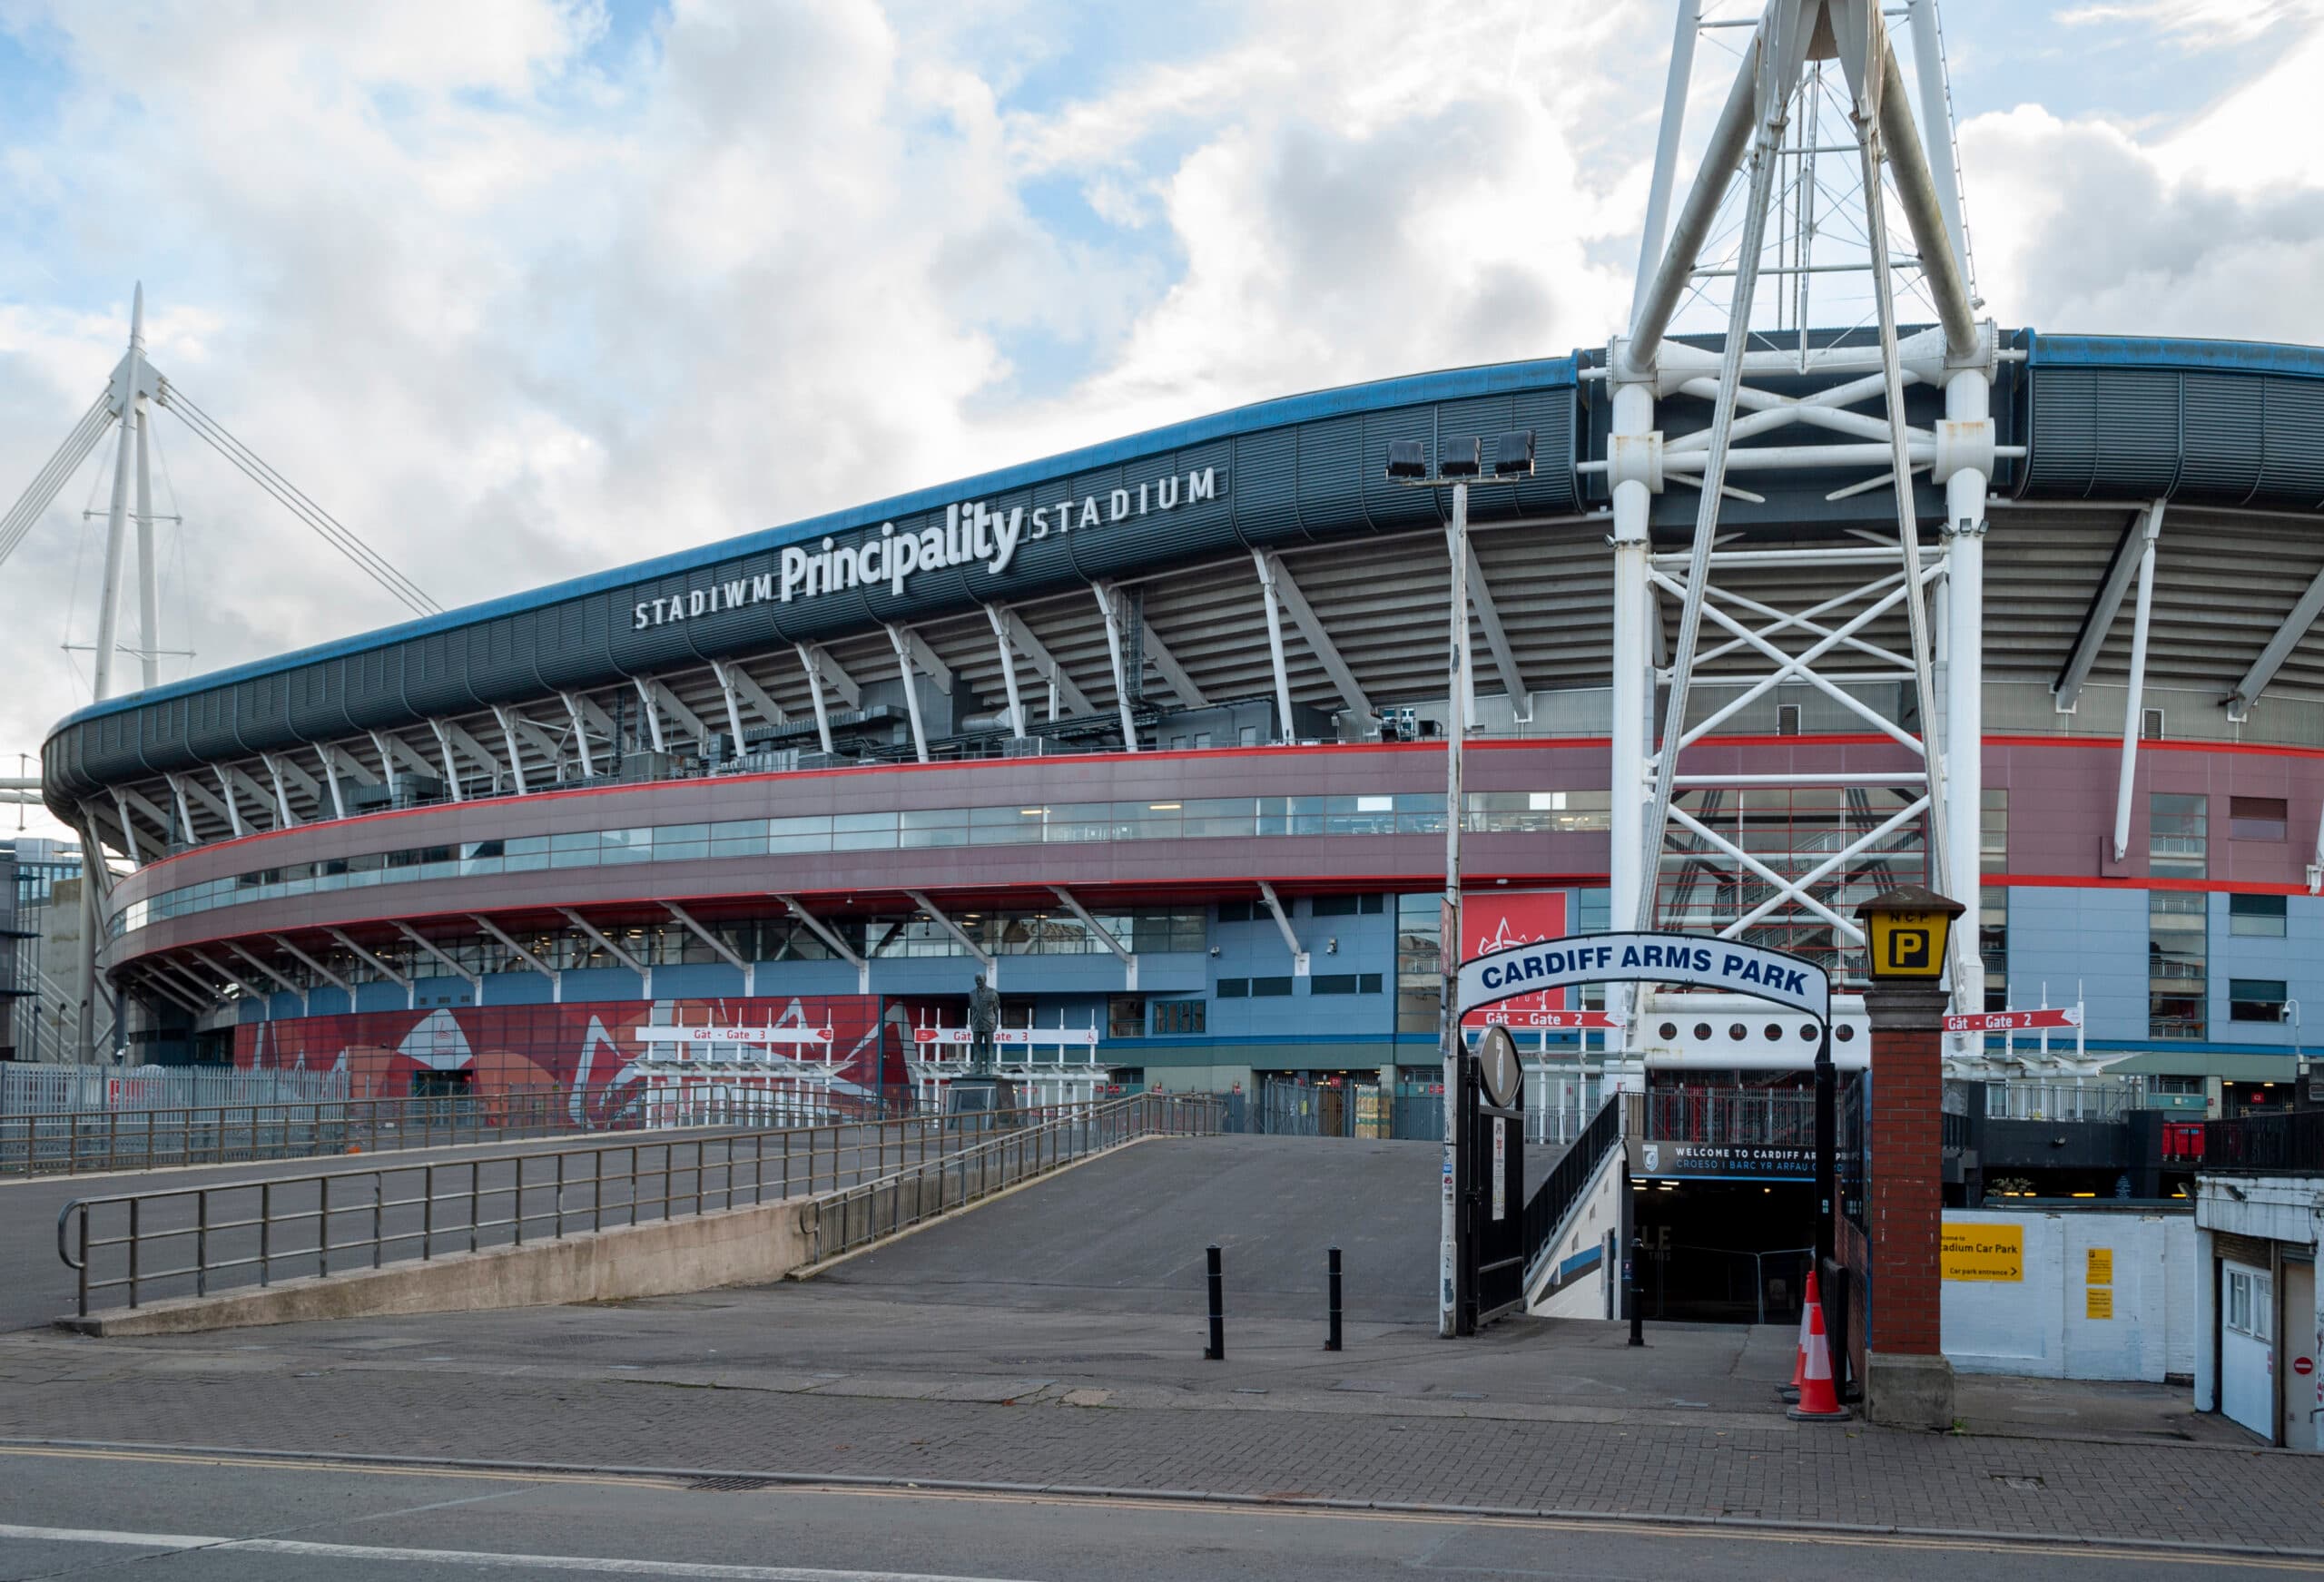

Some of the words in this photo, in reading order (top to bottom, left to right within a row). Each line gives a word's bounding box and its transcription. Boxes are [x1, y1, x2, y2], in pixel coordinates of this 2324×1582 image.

[635, 574, 772, 629] STADIWM
[781, 502, 1023, 603] Principality
[1032, 467, 1215, 539] STADIUM
[1896, 933, 1922, 964] P
[1482, 946, 1613, 989] CARDIFF
[1620, 945, 1712, 973] ARMS
[1722, 954, 1808, 996] PARK
[1530, 1013, 1561, 1025] Gate
[1574, 1013, 1582, 1025] 2
[1948, 1017, 1968, 1030] Gât
[1985, 1015, 2013, 1027] Gate
[2024, 1013, 2032, 1026] 2
[726, 1030, 750, 1039] Gate
[760, 1031, 765, 1039] 3
[995, 1032, 1011, 1041] ate
[1022, 1032, 1029, 1041] 3
[1676, 1147, 1729, 1157] WELCOME
[1735, 1149, 1748, 1158] TO
[1754, 1150, 1799, 1160] CARDIFF
[1676, 1159, 1718, 1169] CROESO
[1729, 1161, 1756, 1170] BARC
[1760, 1161, 1772, 1170] YR
[1941, 1243, 1974, 1253] adium
[1975, 1243, 1993, 1253] Car
[1994, 1244, 2018, 1253] Park
